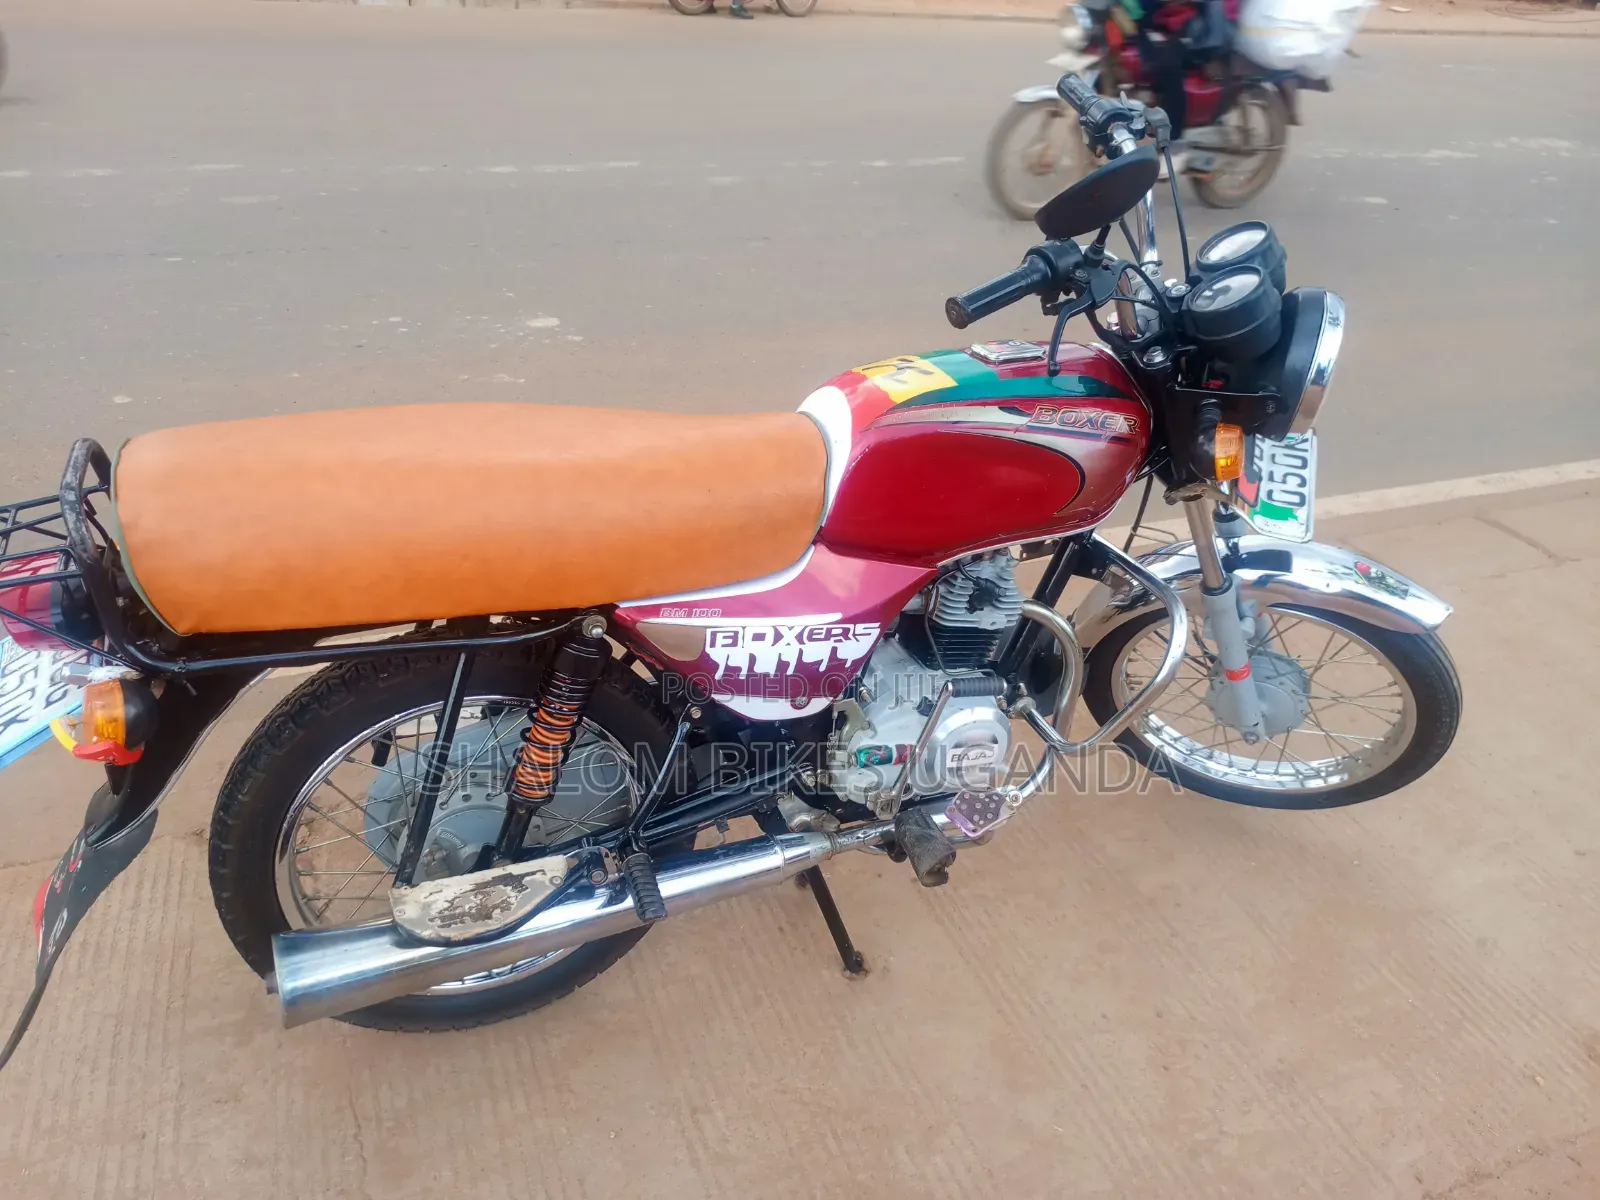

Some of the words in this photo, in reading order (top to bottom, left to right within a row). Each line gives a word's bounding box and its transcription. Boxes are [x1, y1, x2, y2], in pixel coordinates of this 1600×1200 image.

[1031, 404, 1140, 434] BOXER
[660, 607, 688, 618] BM
[692, 608, 722, 618] 100
[705, 621, 881, 655] BOXERS
[950, 750, 995, 763] BAJAJ
